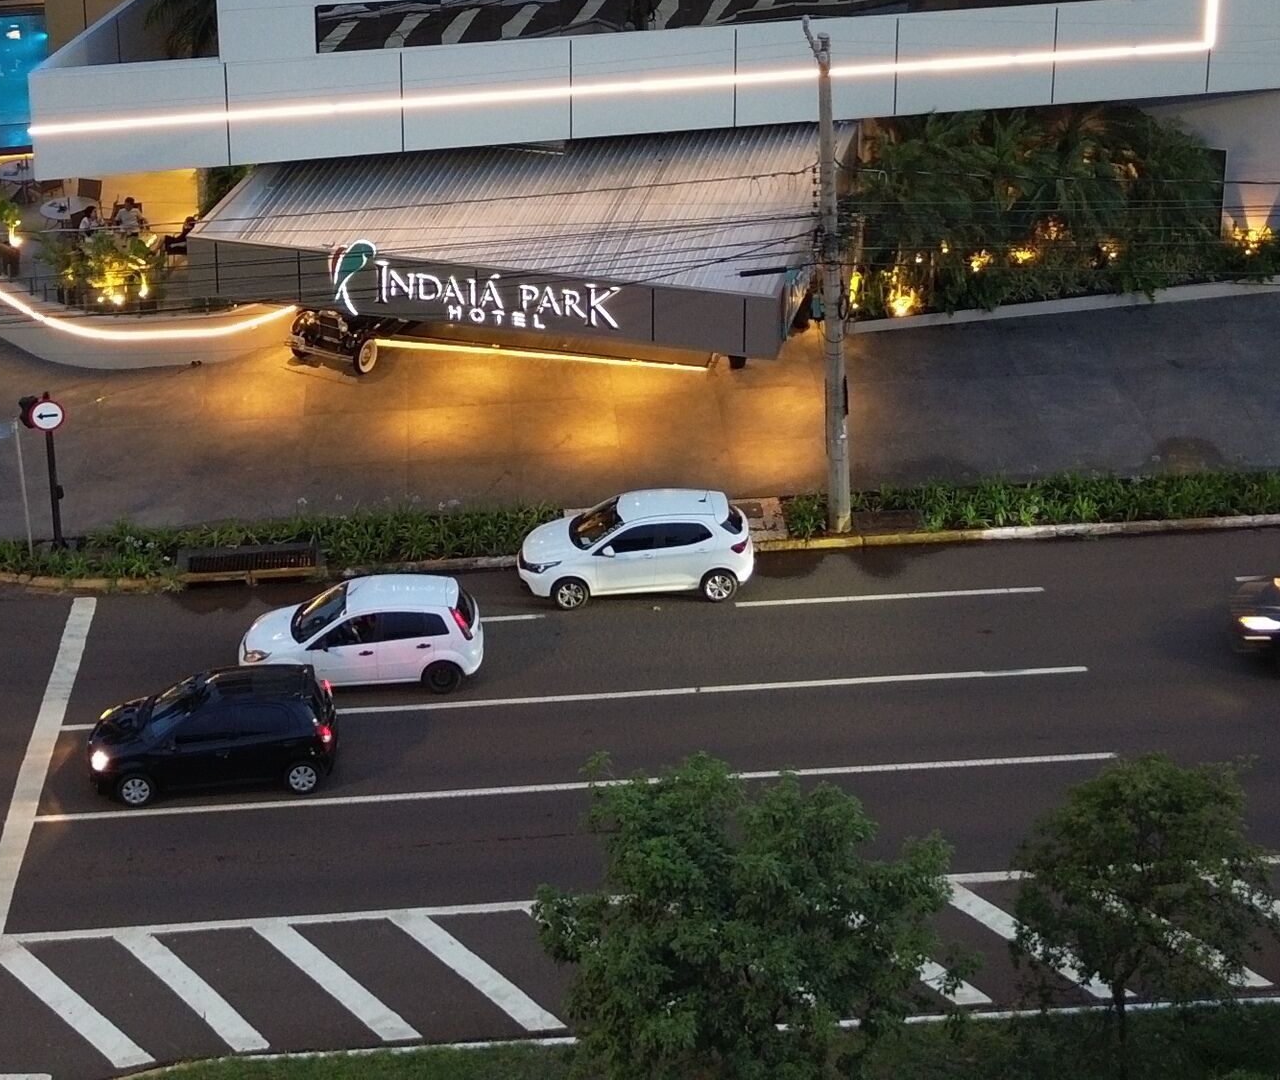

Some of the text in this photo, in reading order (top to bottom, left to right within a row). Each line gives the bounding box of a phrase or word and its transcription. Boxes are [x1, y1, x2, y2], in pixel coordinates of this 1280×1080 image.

[374, 260, 621, 330] INDAIÁ PARK
[447, 305, 546, 329] HOTEL
